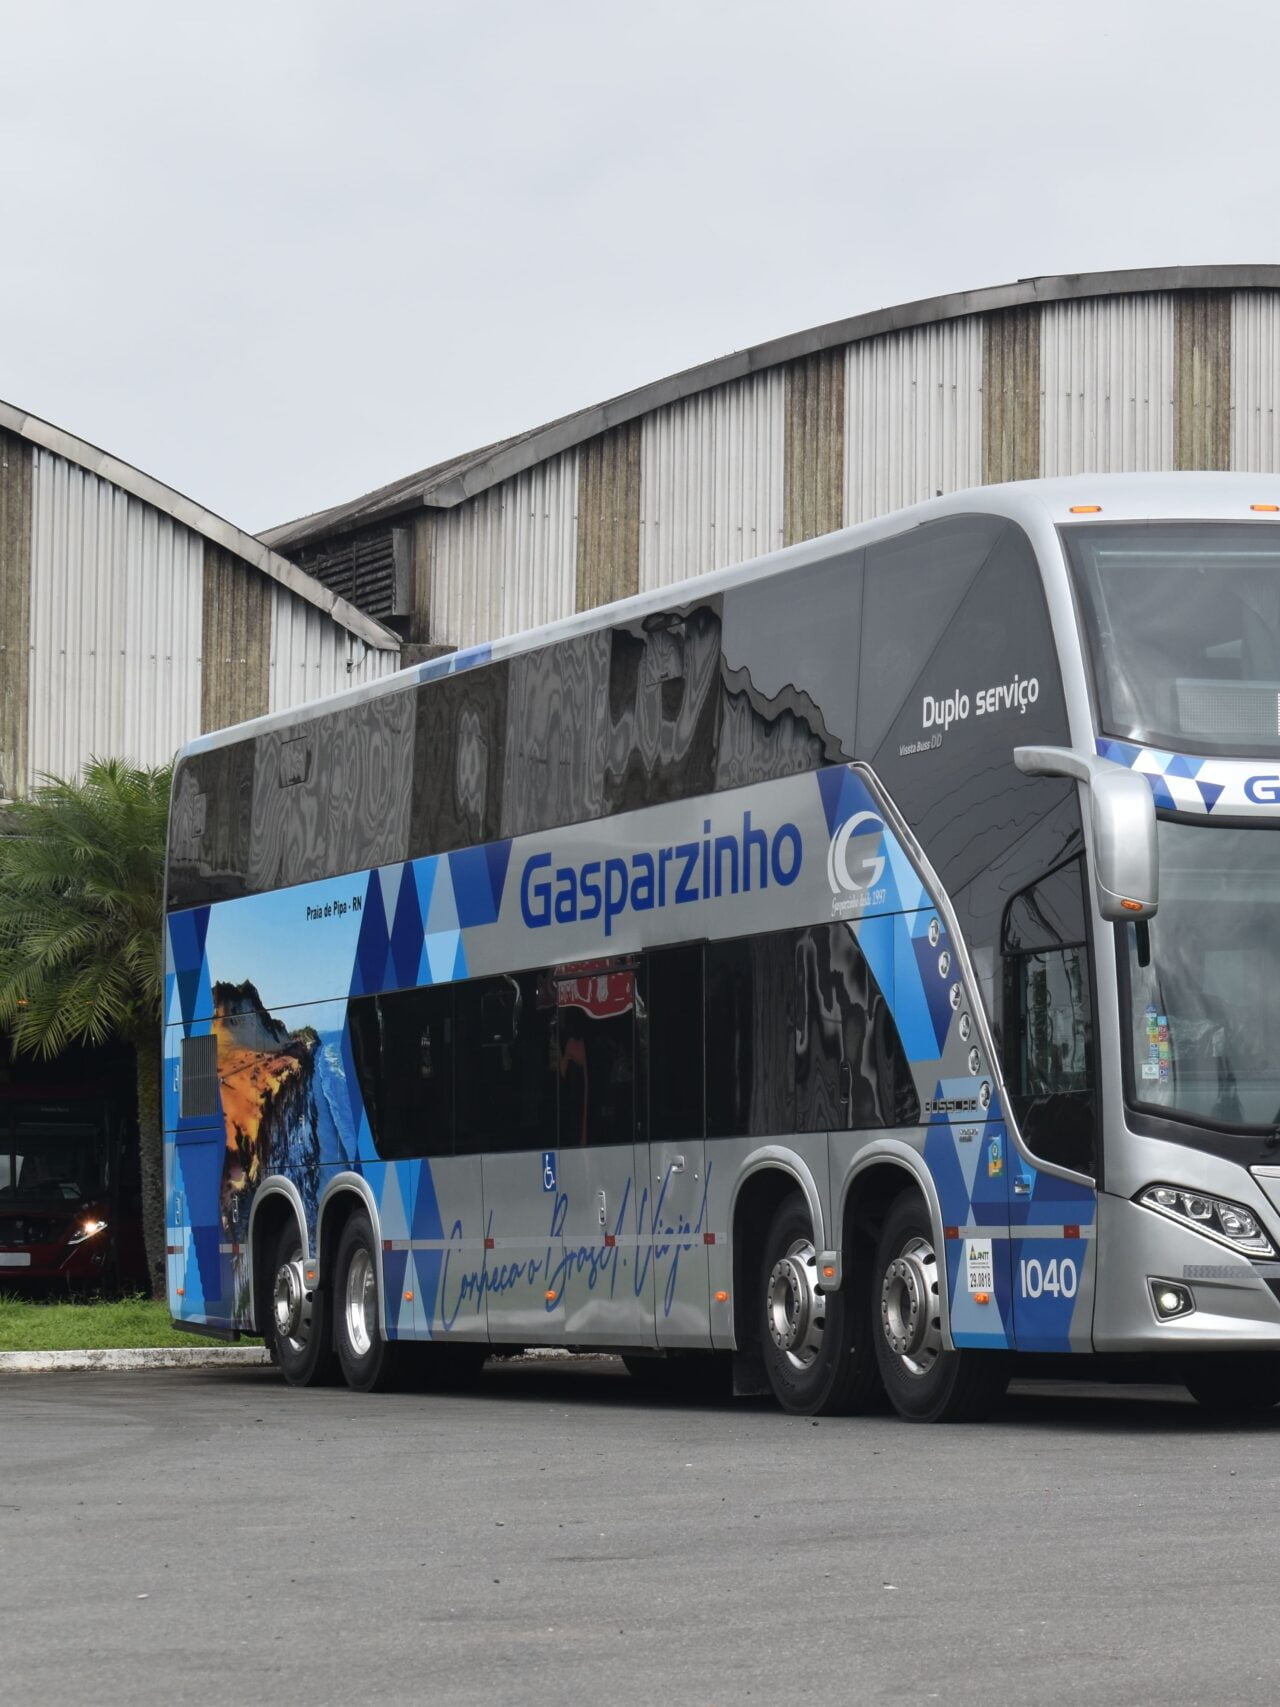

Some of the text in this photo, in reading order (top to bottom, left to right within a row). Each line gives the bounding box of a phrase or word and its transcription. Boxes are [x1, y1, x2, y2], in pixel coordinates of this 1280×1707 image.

[922, 674, 1039, 731] Duplo serviço
[520, 811, 803, 937] Gasparzinho
[306, 905, 323, 921] Praia
[324, 903, 332, 917] de
[333, 900, 347, 918] Pipa
[353, 896, 362, 912] RN
[977, 1251, 989, 1260] ANTT
[1021, 1258, 1077, 1298] 1040
